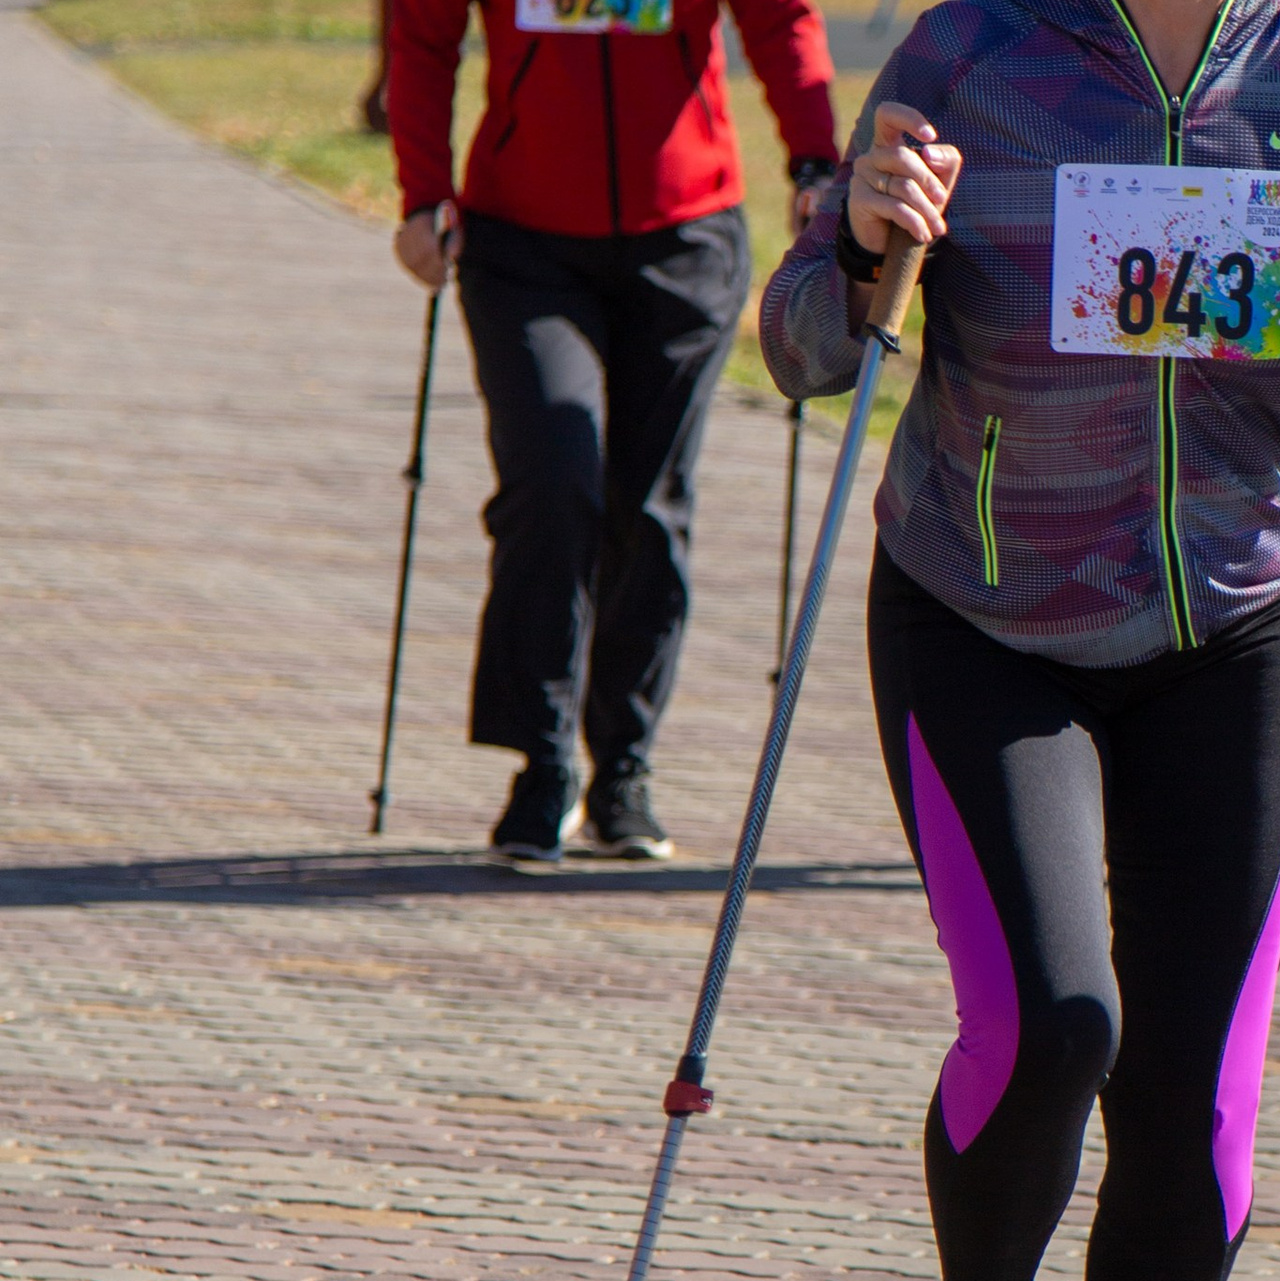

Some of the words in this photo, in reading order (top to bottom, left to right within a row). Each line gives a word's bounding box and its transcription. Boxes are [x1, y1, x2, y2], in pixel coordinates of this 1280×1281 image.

[1246, 216, 1266, 226] ДЕНЬ
[1262, 227, 1280, 237] 2024
[1117, 247, 1255, 340] 843
